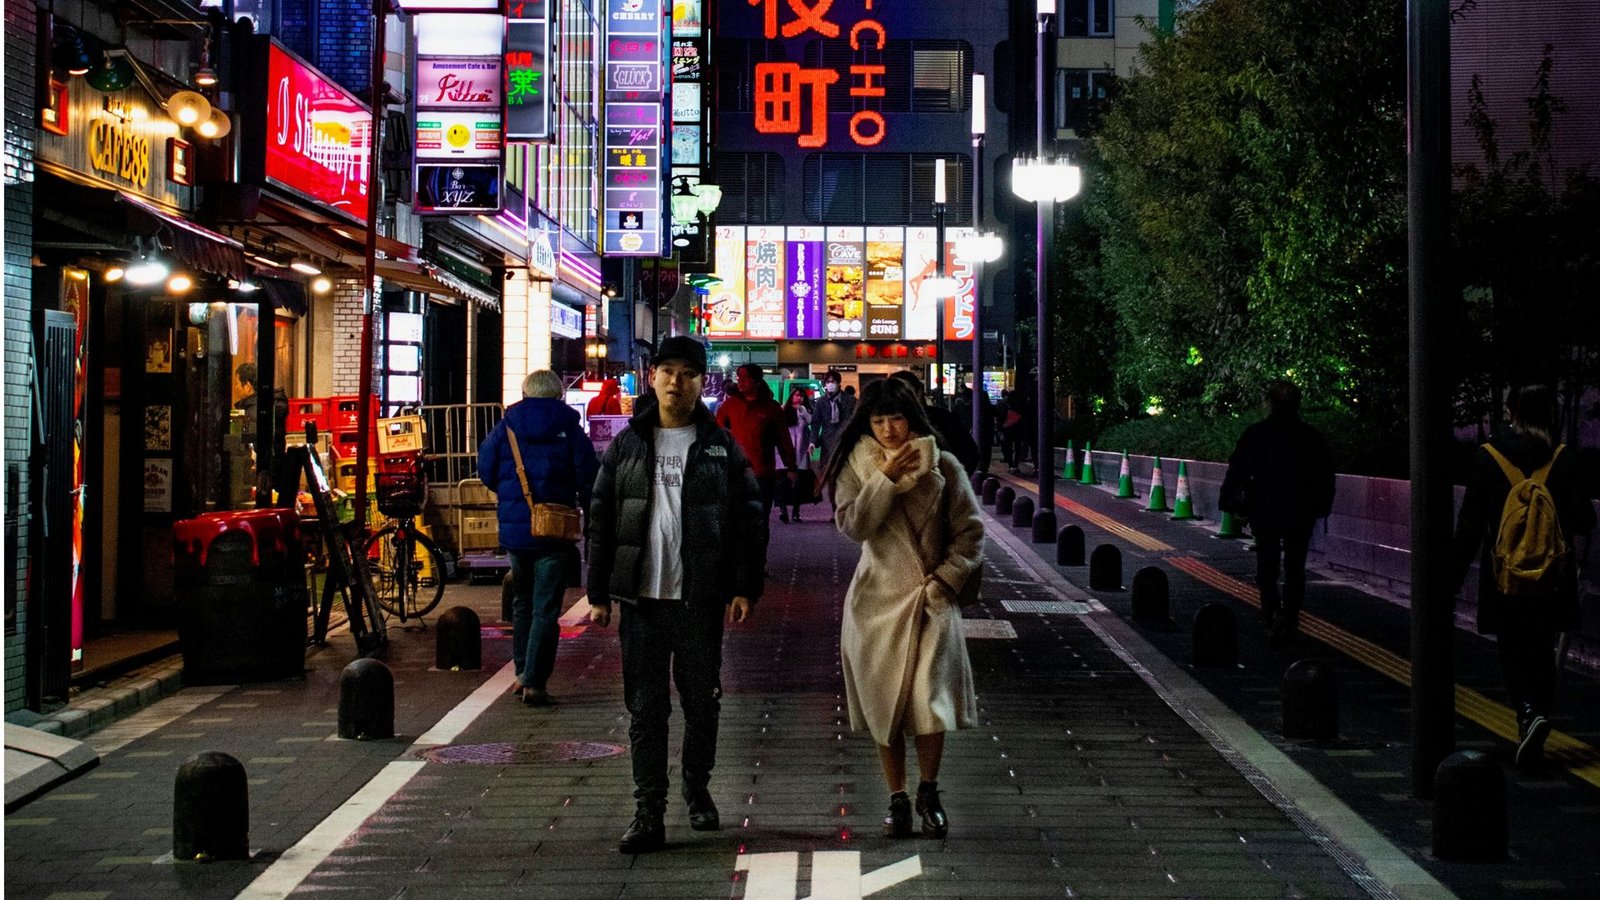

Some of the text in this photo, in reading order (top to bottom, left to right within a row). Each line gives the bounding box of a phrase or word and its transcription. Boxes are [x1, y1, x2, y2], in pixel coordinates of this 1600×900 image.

[612, 12, 655, 20] CHERRY
[432, 62, 467, 70] Amusement
[467, 62, 480, 70] Cafe
[618, 67, 646, 86] GLÜCK
[419, 94, 429, 104] 2F
[756, 241, 778, 289] 焼肉
[870, 324, 899, 335] SUNS
